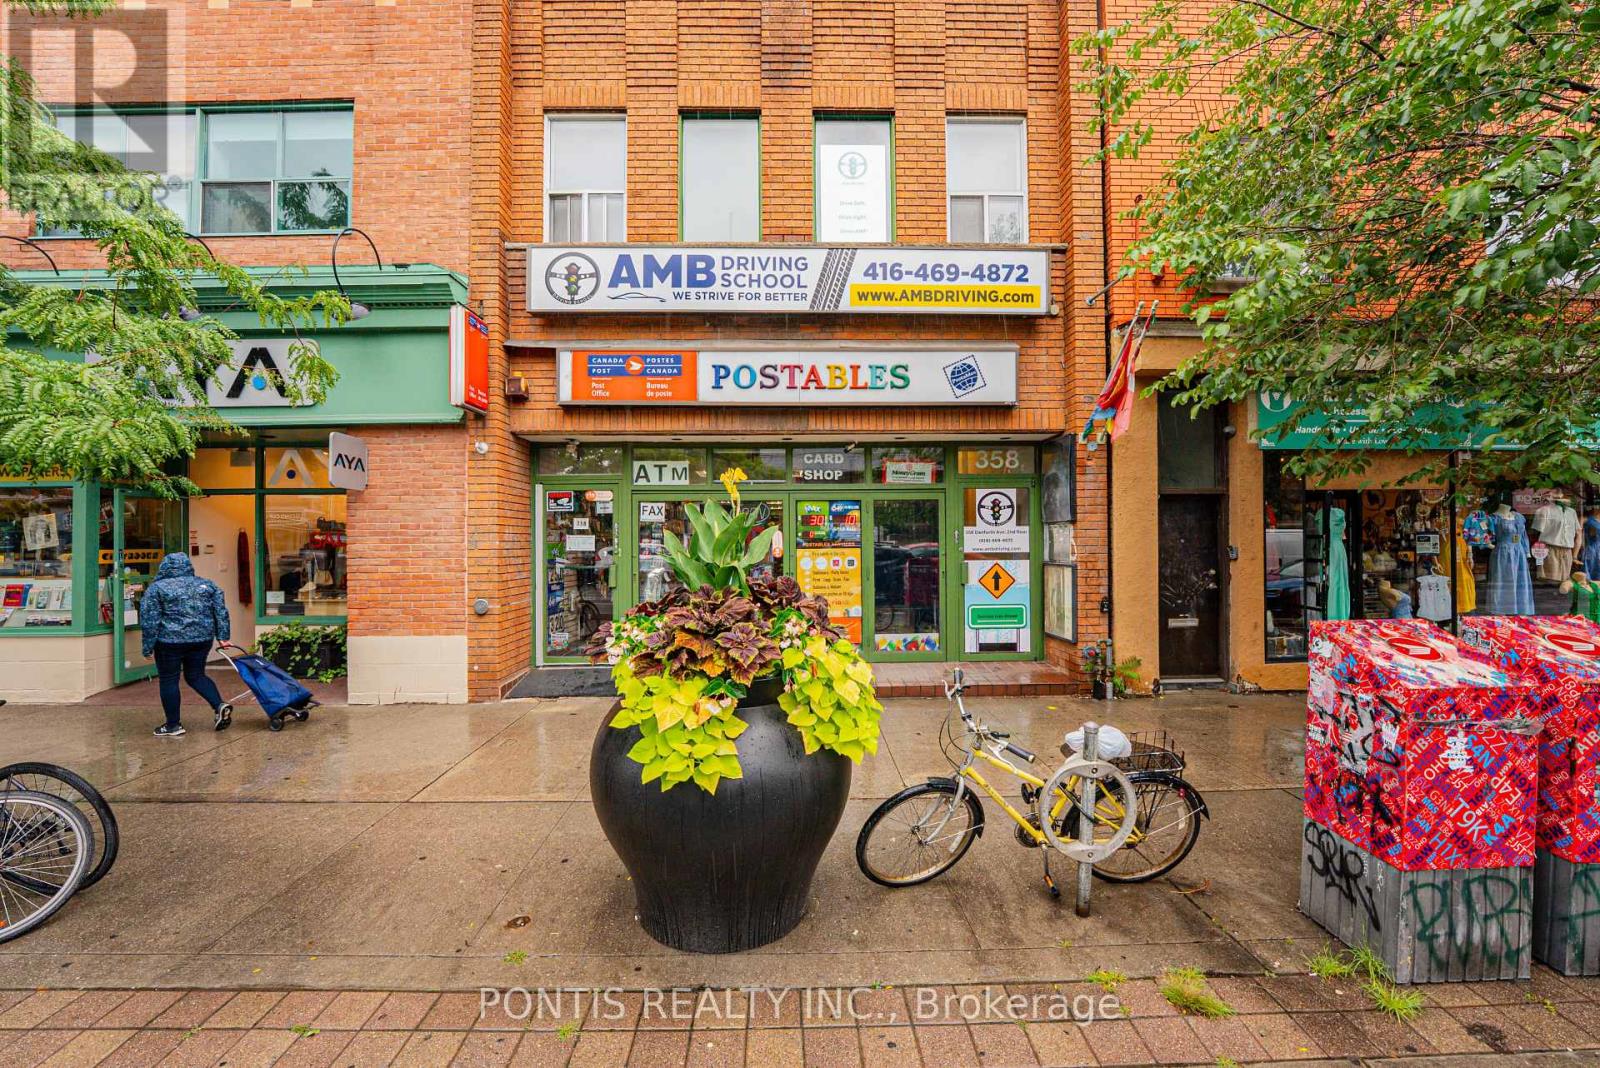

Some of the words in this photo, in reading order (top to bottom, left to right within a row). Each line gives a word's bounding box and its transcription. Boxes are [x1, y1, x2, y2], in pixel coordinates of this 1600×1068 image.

[607, 254, 716, 288] AMB
[721, 256, 808, 272] DRIVING
[863, 262, 1030, 283] 416-469-4872
[721, 272, 808, 288] SCHOOL
[673, 291, 690, 300] WE
[695, 292, 734, 301] STRIVE
[738, 292, 761, 301] FOR
[764, 292, 808, 302] BETTER
[857, 290, 1034, 303] www.AMBDRIVING.com
[711, 364, 910, 390] POSTABLES
[334, 453, 366, 472] AYA
[804, 453, 844, 464] CARD
[976, 450, 1020, 470] 358
[634, 464, 688, 484] ATM
[804, 470, 843, 481] SHOP
[642, 506, 664, 516] FAX
[845, 515, 856, 525] 10
[810, 516, 824, 526] 30
[1404, 736, 1431, 763] A1B
[1461, 733, 1497, 769] S4N
[1446, 797, 1490, 842] T9K
[1481, 811, 1516, 846] K4A
[1428, 832, 1463, 866] H1X
